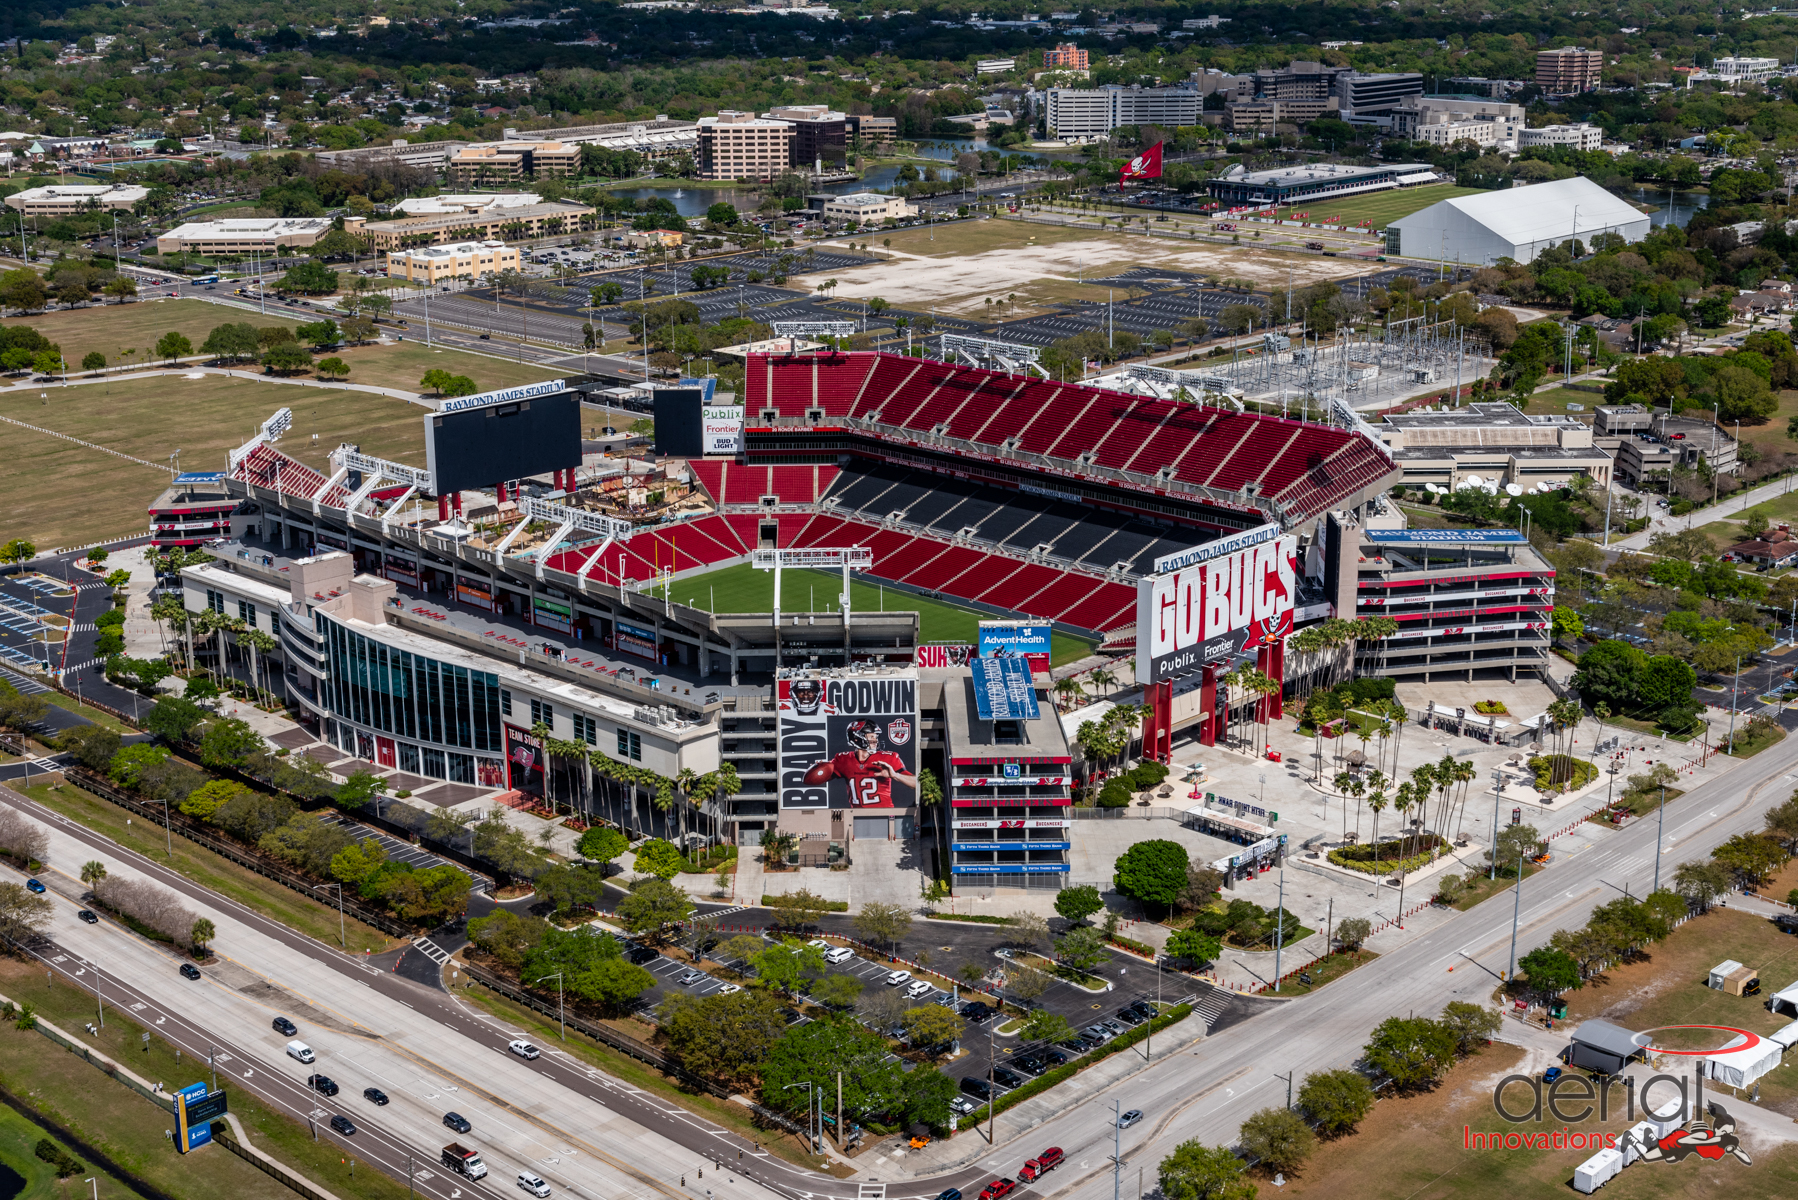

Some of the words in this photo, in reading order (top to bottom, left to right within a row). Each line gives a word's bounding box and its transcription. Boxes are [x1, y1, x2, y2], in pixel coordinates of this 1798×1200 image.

[445, 395, 493, 412] RAYMOND
[494, 389, 524, 403] JAMES
[526, 382, 564, 397] STADIUM
[703, 409, 740, 418] Publix
[706, 425, 739, 433] Frontier
[910, 462, 932, 471] CHAMPIONS
[1165, 492, 1185, 500] MALCOLM
[1186, 494, 1203, 504] GLAZER
[1230, 504, 1248, 512] GRUBER
[1162, 549, 1210, 573] RAYMOND
[1210, 540, 1241, 558] JAMES
[1242, 526, 1279, 548] STADIUM
[1424, 574, 1490, 585] BUCCANEERS
[1152, 567, 1201, 659] GO
[1205, 535, 1296, 641] BUCS
[1422, 608, 1487, 620] BUCCANEERS
[984, 636, 1044, 644] AdventHealth
[1204, 639, 1234, 657] Frontier
[918, 646, 946, 668] SUH
[1160, 653, 1196, 674] Publix
[1204, 650, 1232, 661] COMMUNICATIONS
[982, 659, 1002, 681] JAMES
[1005, 672, 1027, 702] STADIUM
[828, 680, 915, 714] GODWIN
[986, 681, 1010, 718] RAYMOND
[508, 728, 523, 742] TEAM
[524, 734, 541, 748] STORE
[780, 717, 828, 808] BRADY
[972, 756, 1054, 765] BUCCANEERS
[848, 778, 880, 806] 12
[972, 799, 1054, 807] BUCCANEERS
[192, 1088, 205, 1098] HCC
